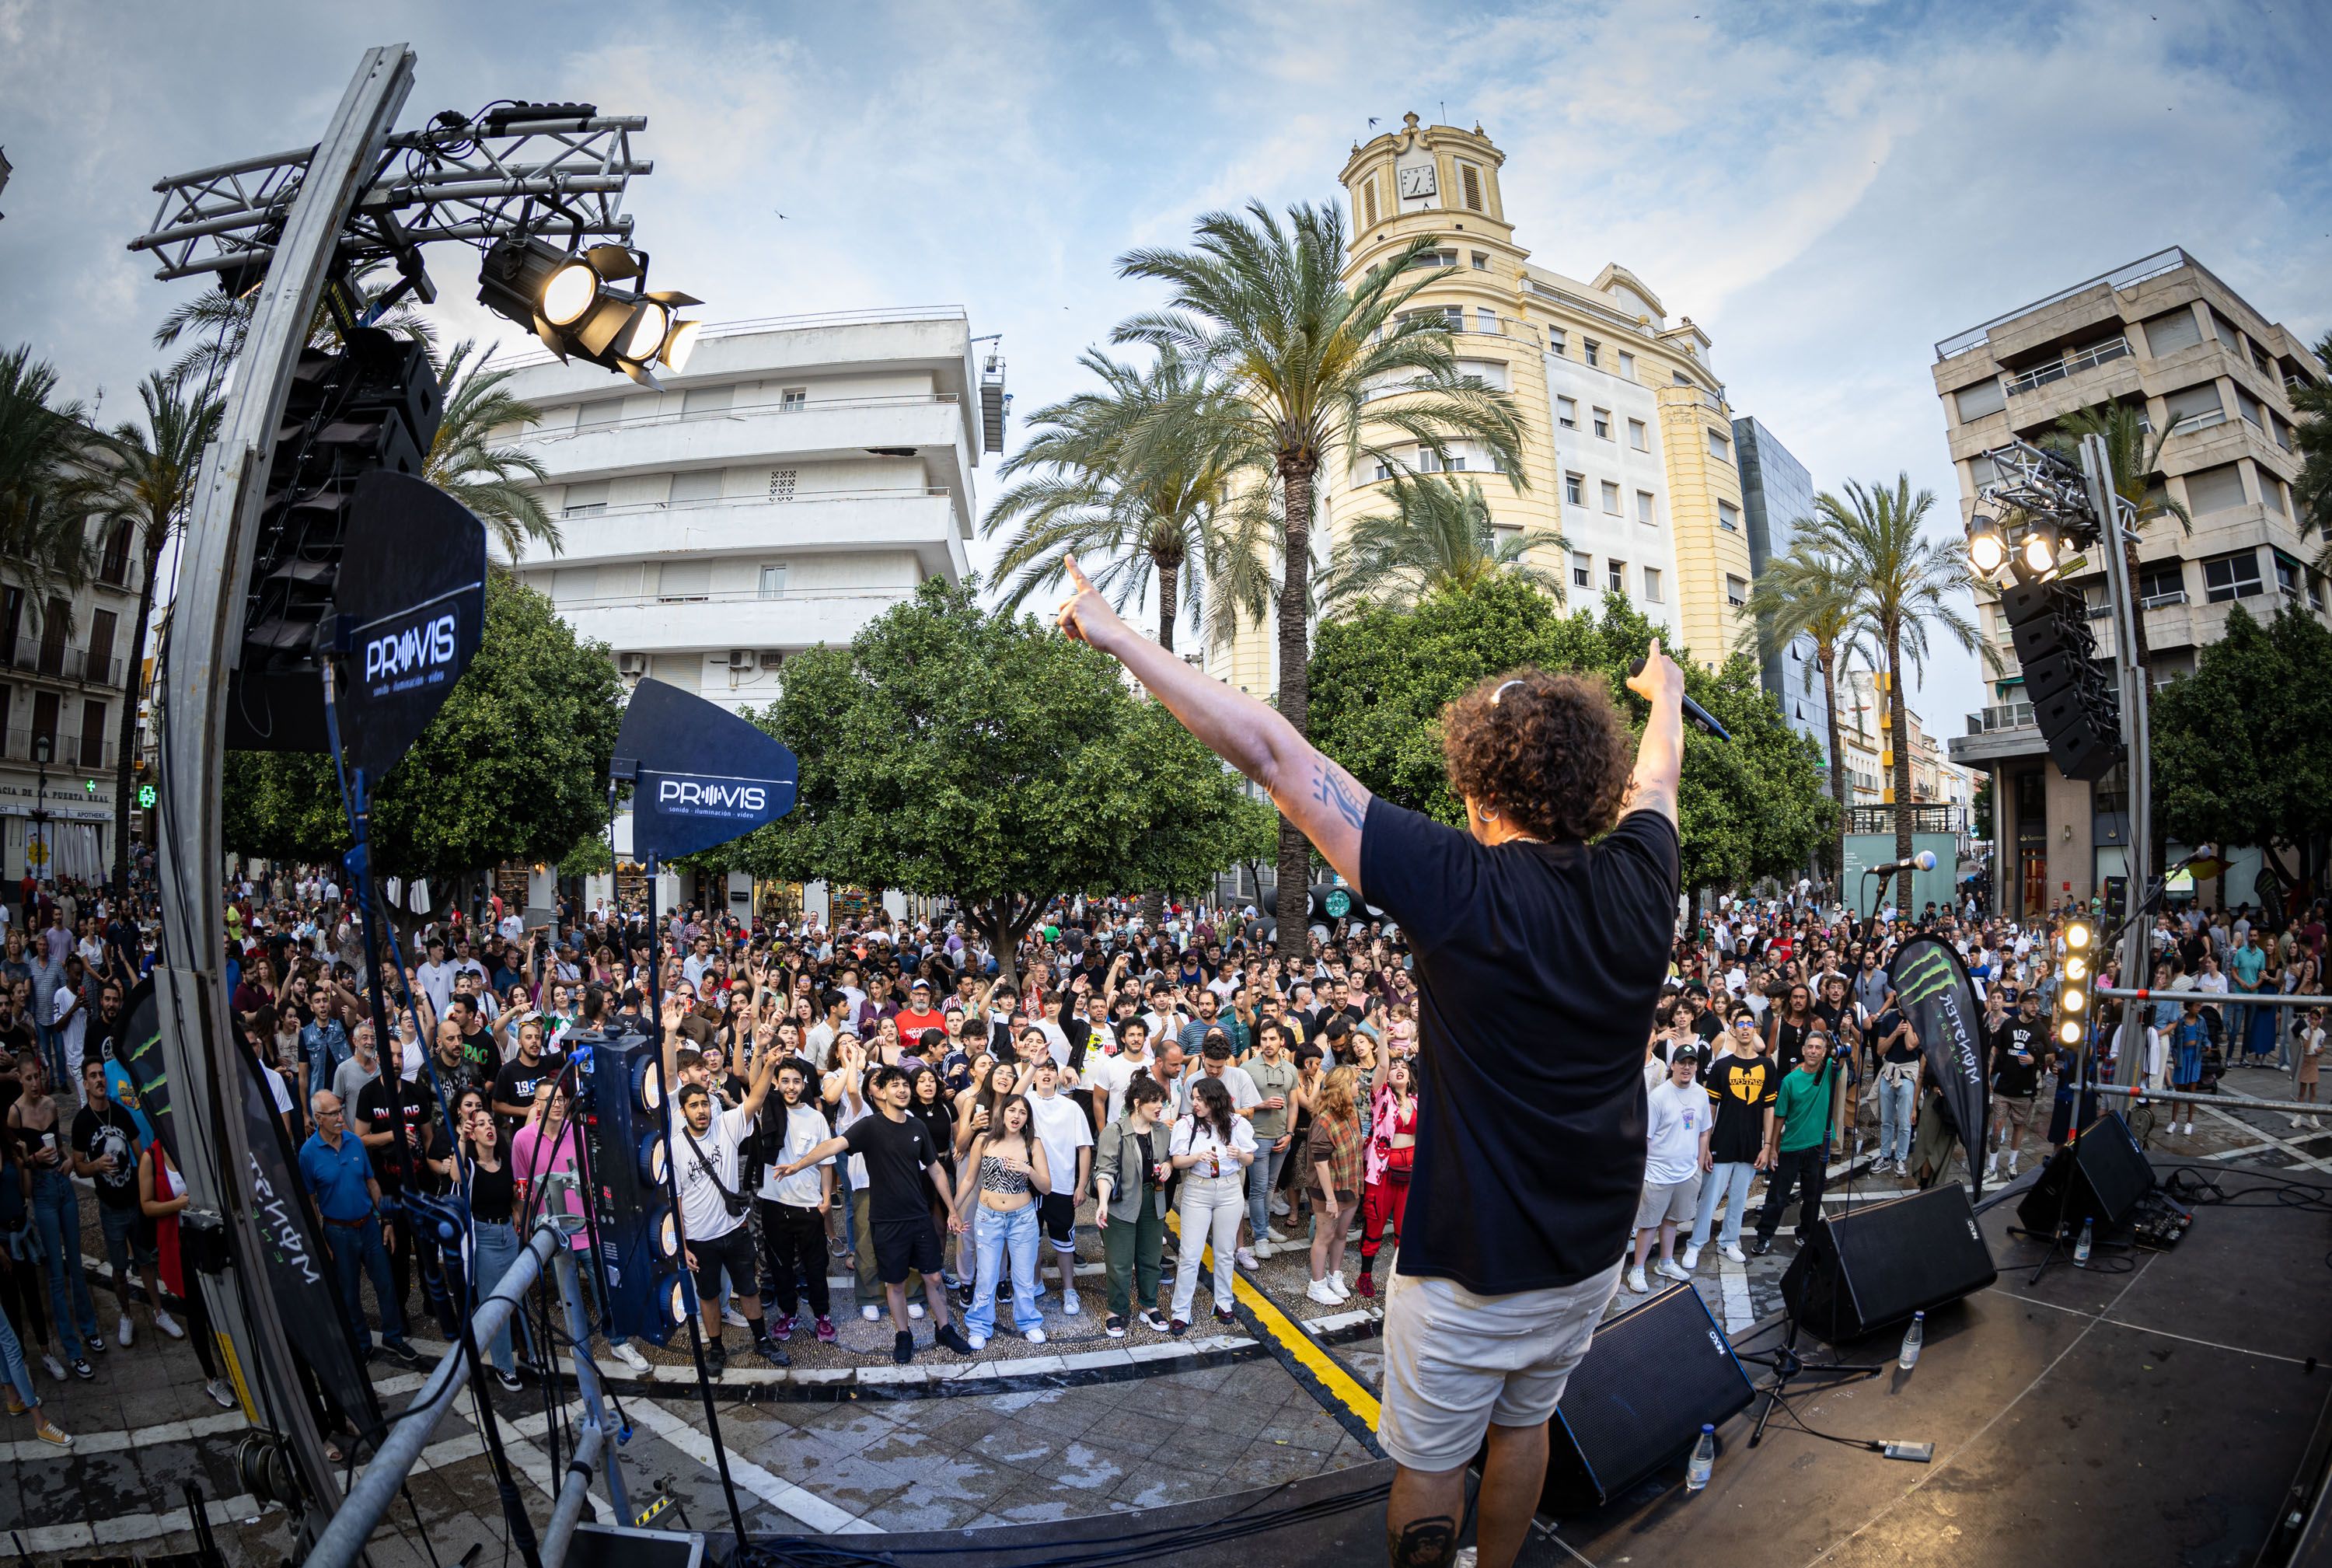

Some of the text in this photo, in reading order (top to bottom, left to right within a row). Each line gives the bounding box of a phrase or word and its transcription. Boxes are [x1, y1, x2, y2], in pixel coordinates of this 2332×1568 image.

[89, 794, 109, 803] REAL
[2013, 1028, 2031, 1042] NETS
[463, 1043, 488, 1064] PAC
[1709, 1330, 1726, 1355] NEXO
